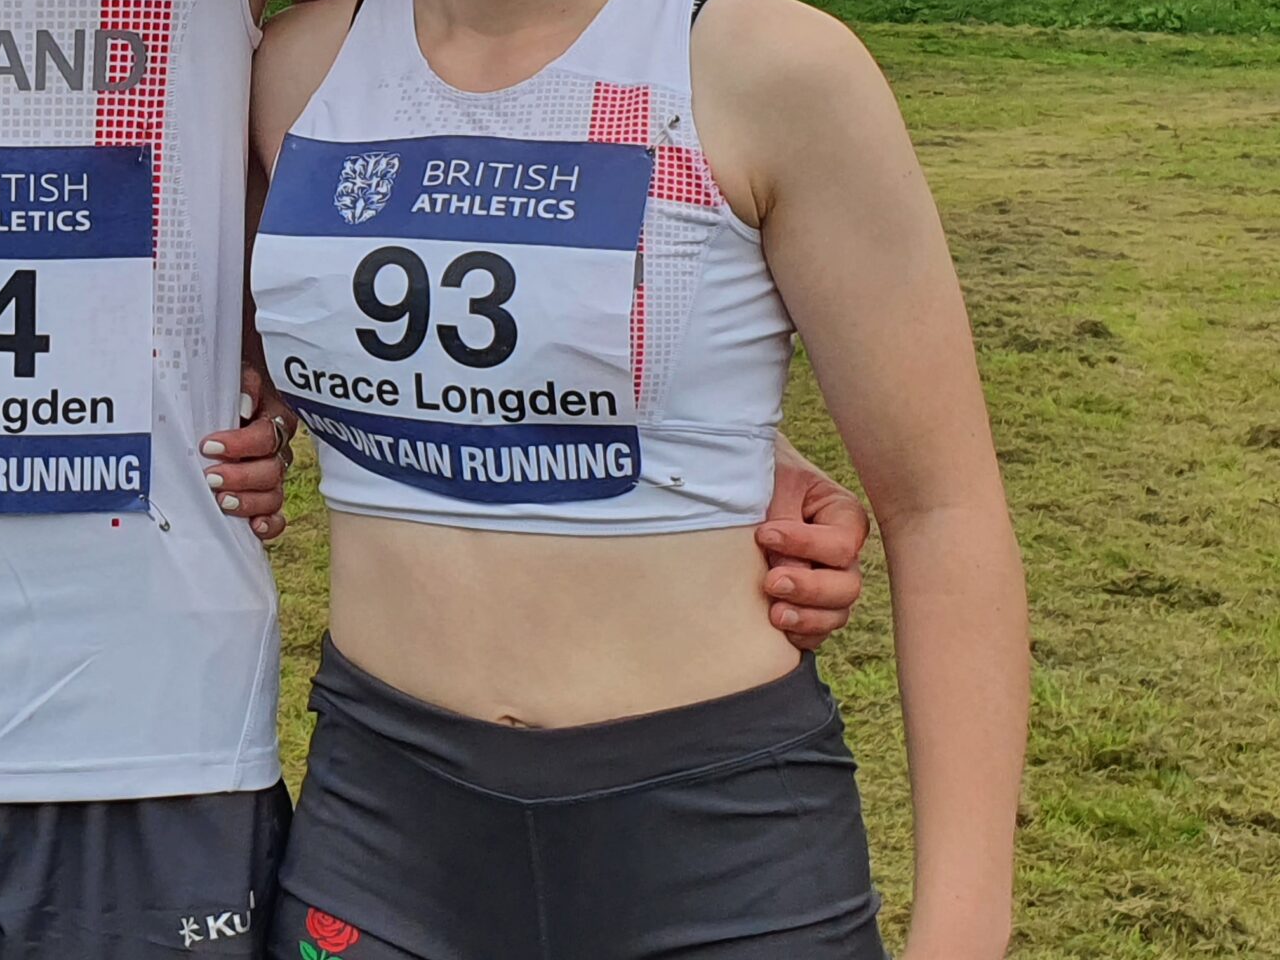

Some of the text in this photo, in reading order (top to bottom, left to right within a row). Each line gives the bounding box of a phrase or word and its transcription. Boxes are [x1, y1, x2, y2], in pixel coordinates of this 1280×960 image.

[410, 193, 576, 221] ATHLETICS
[422, 159, 580, 193] BRITISH
[352, 245, 519, 369] 93
[284, 355, 617, 423] Grace Longden
[298, 407, 633, 483] MOUNTAIN RUNNING
